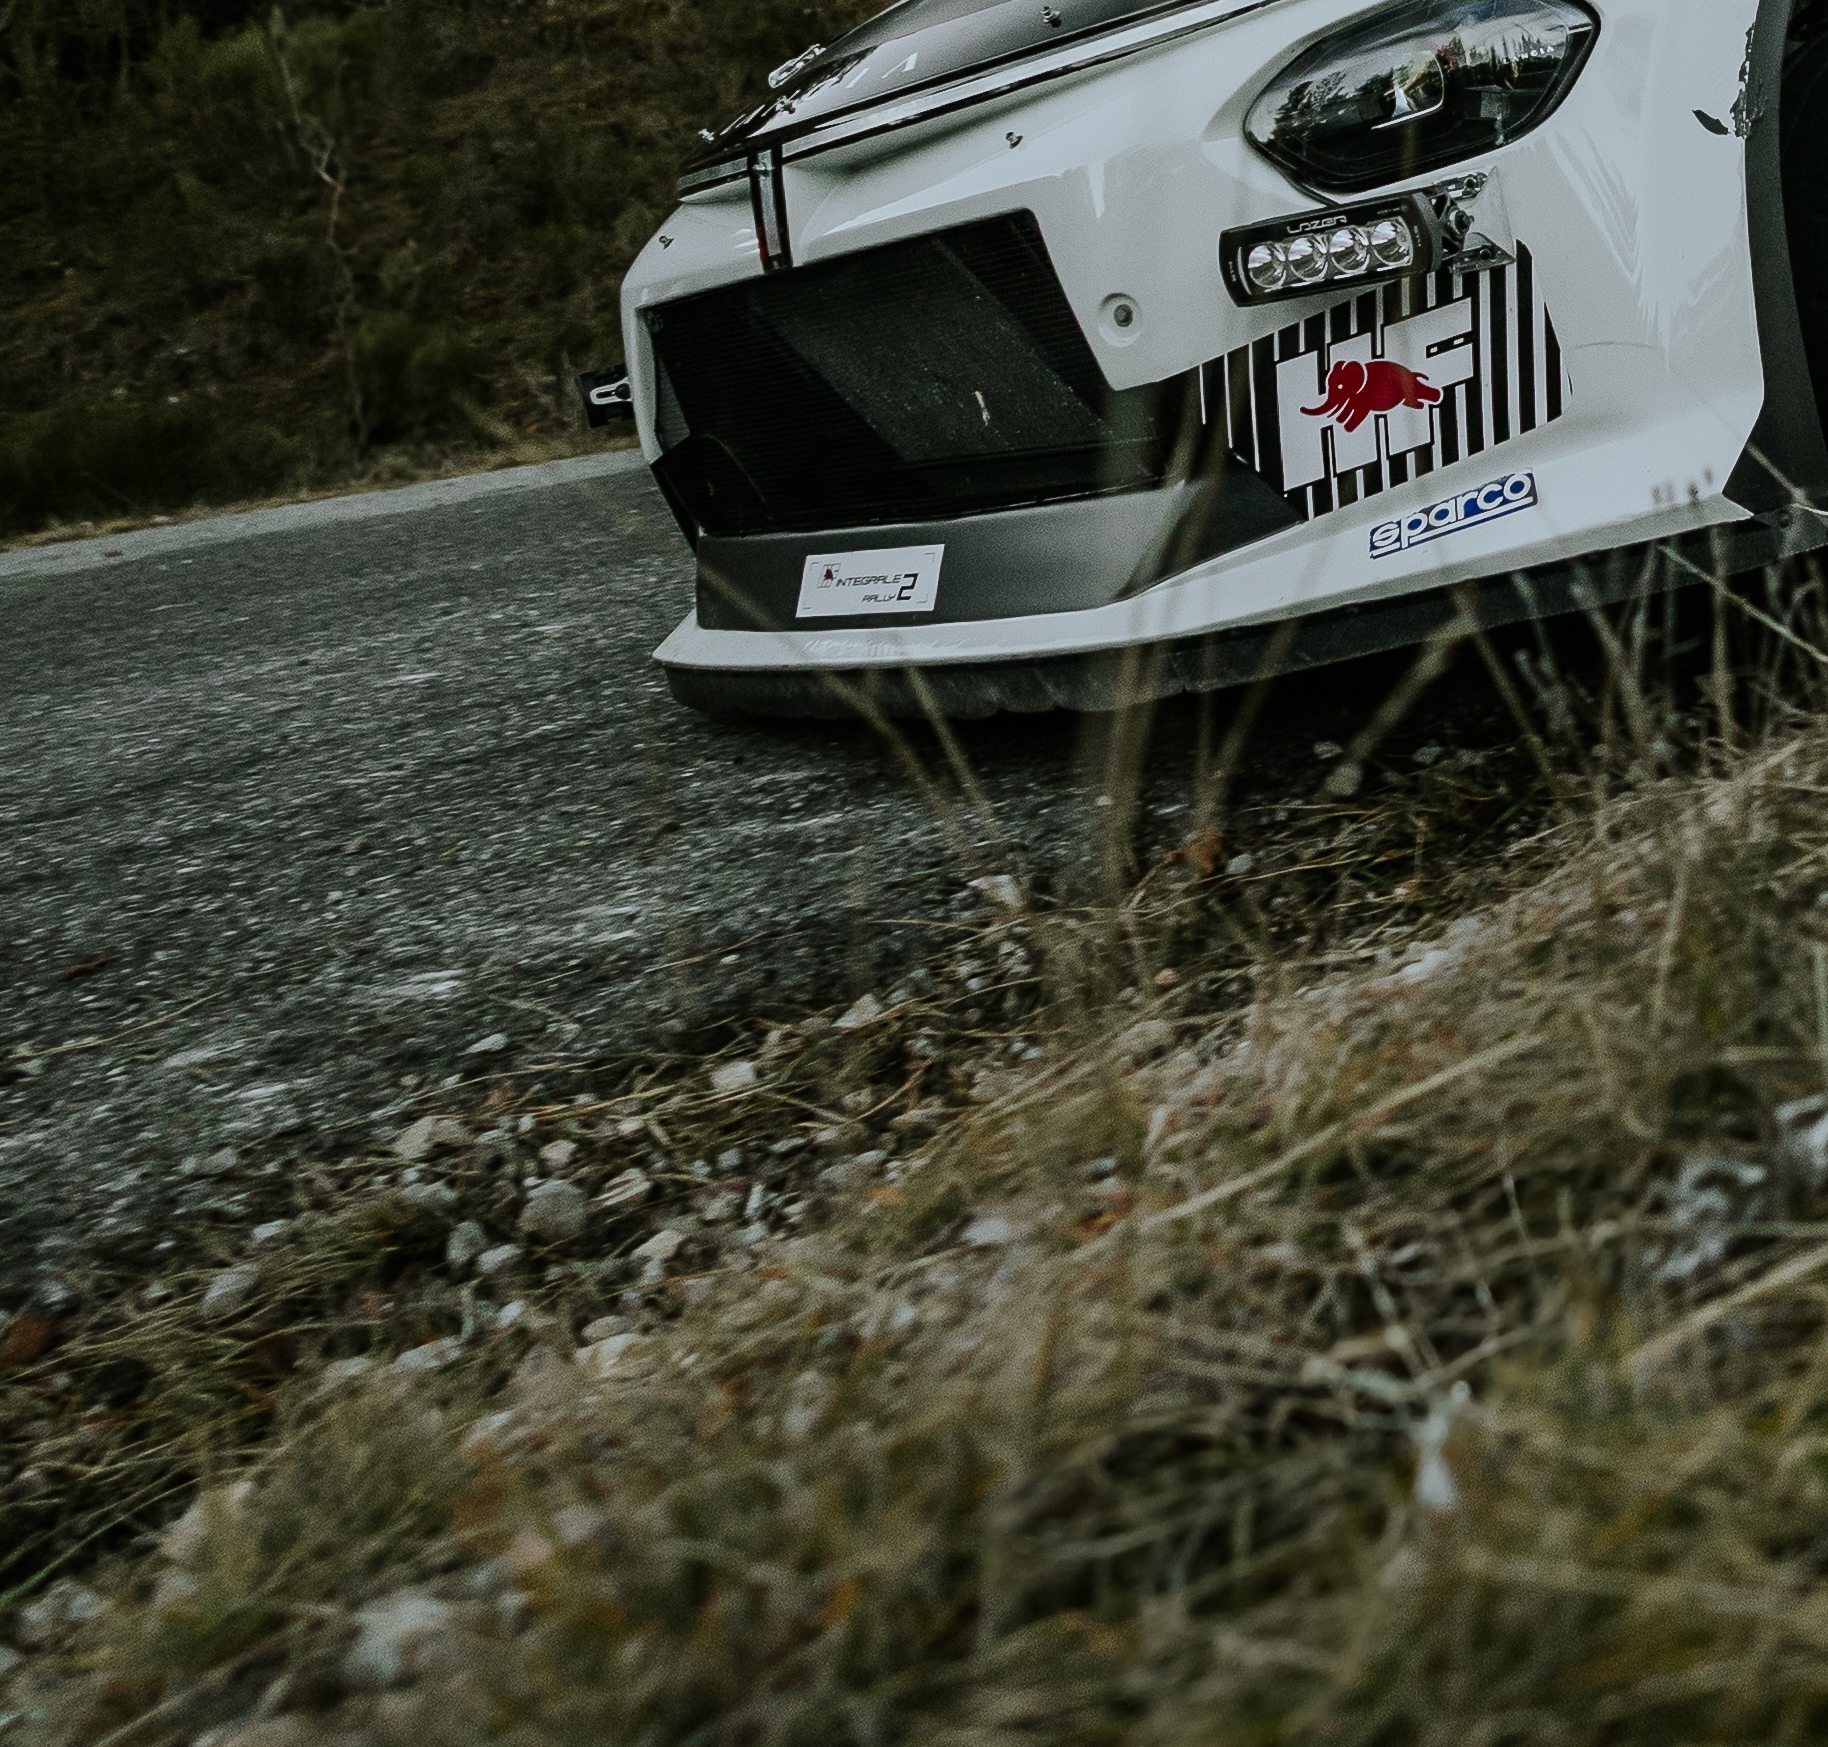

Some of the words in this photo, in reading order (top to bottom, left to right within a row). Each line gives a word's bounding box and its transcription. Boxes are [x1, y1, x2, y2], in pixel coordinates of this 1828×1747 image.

[1287, 215, 1347, 234] LAZER
[1275, 296, 1474, 492] HF
[1371, 472, 1532, 548] sparco
[835, 573, 902, 587] INTEGRALE
[861, 594, 896, 603] RALLY
[896, 573, 919, 601] 2
